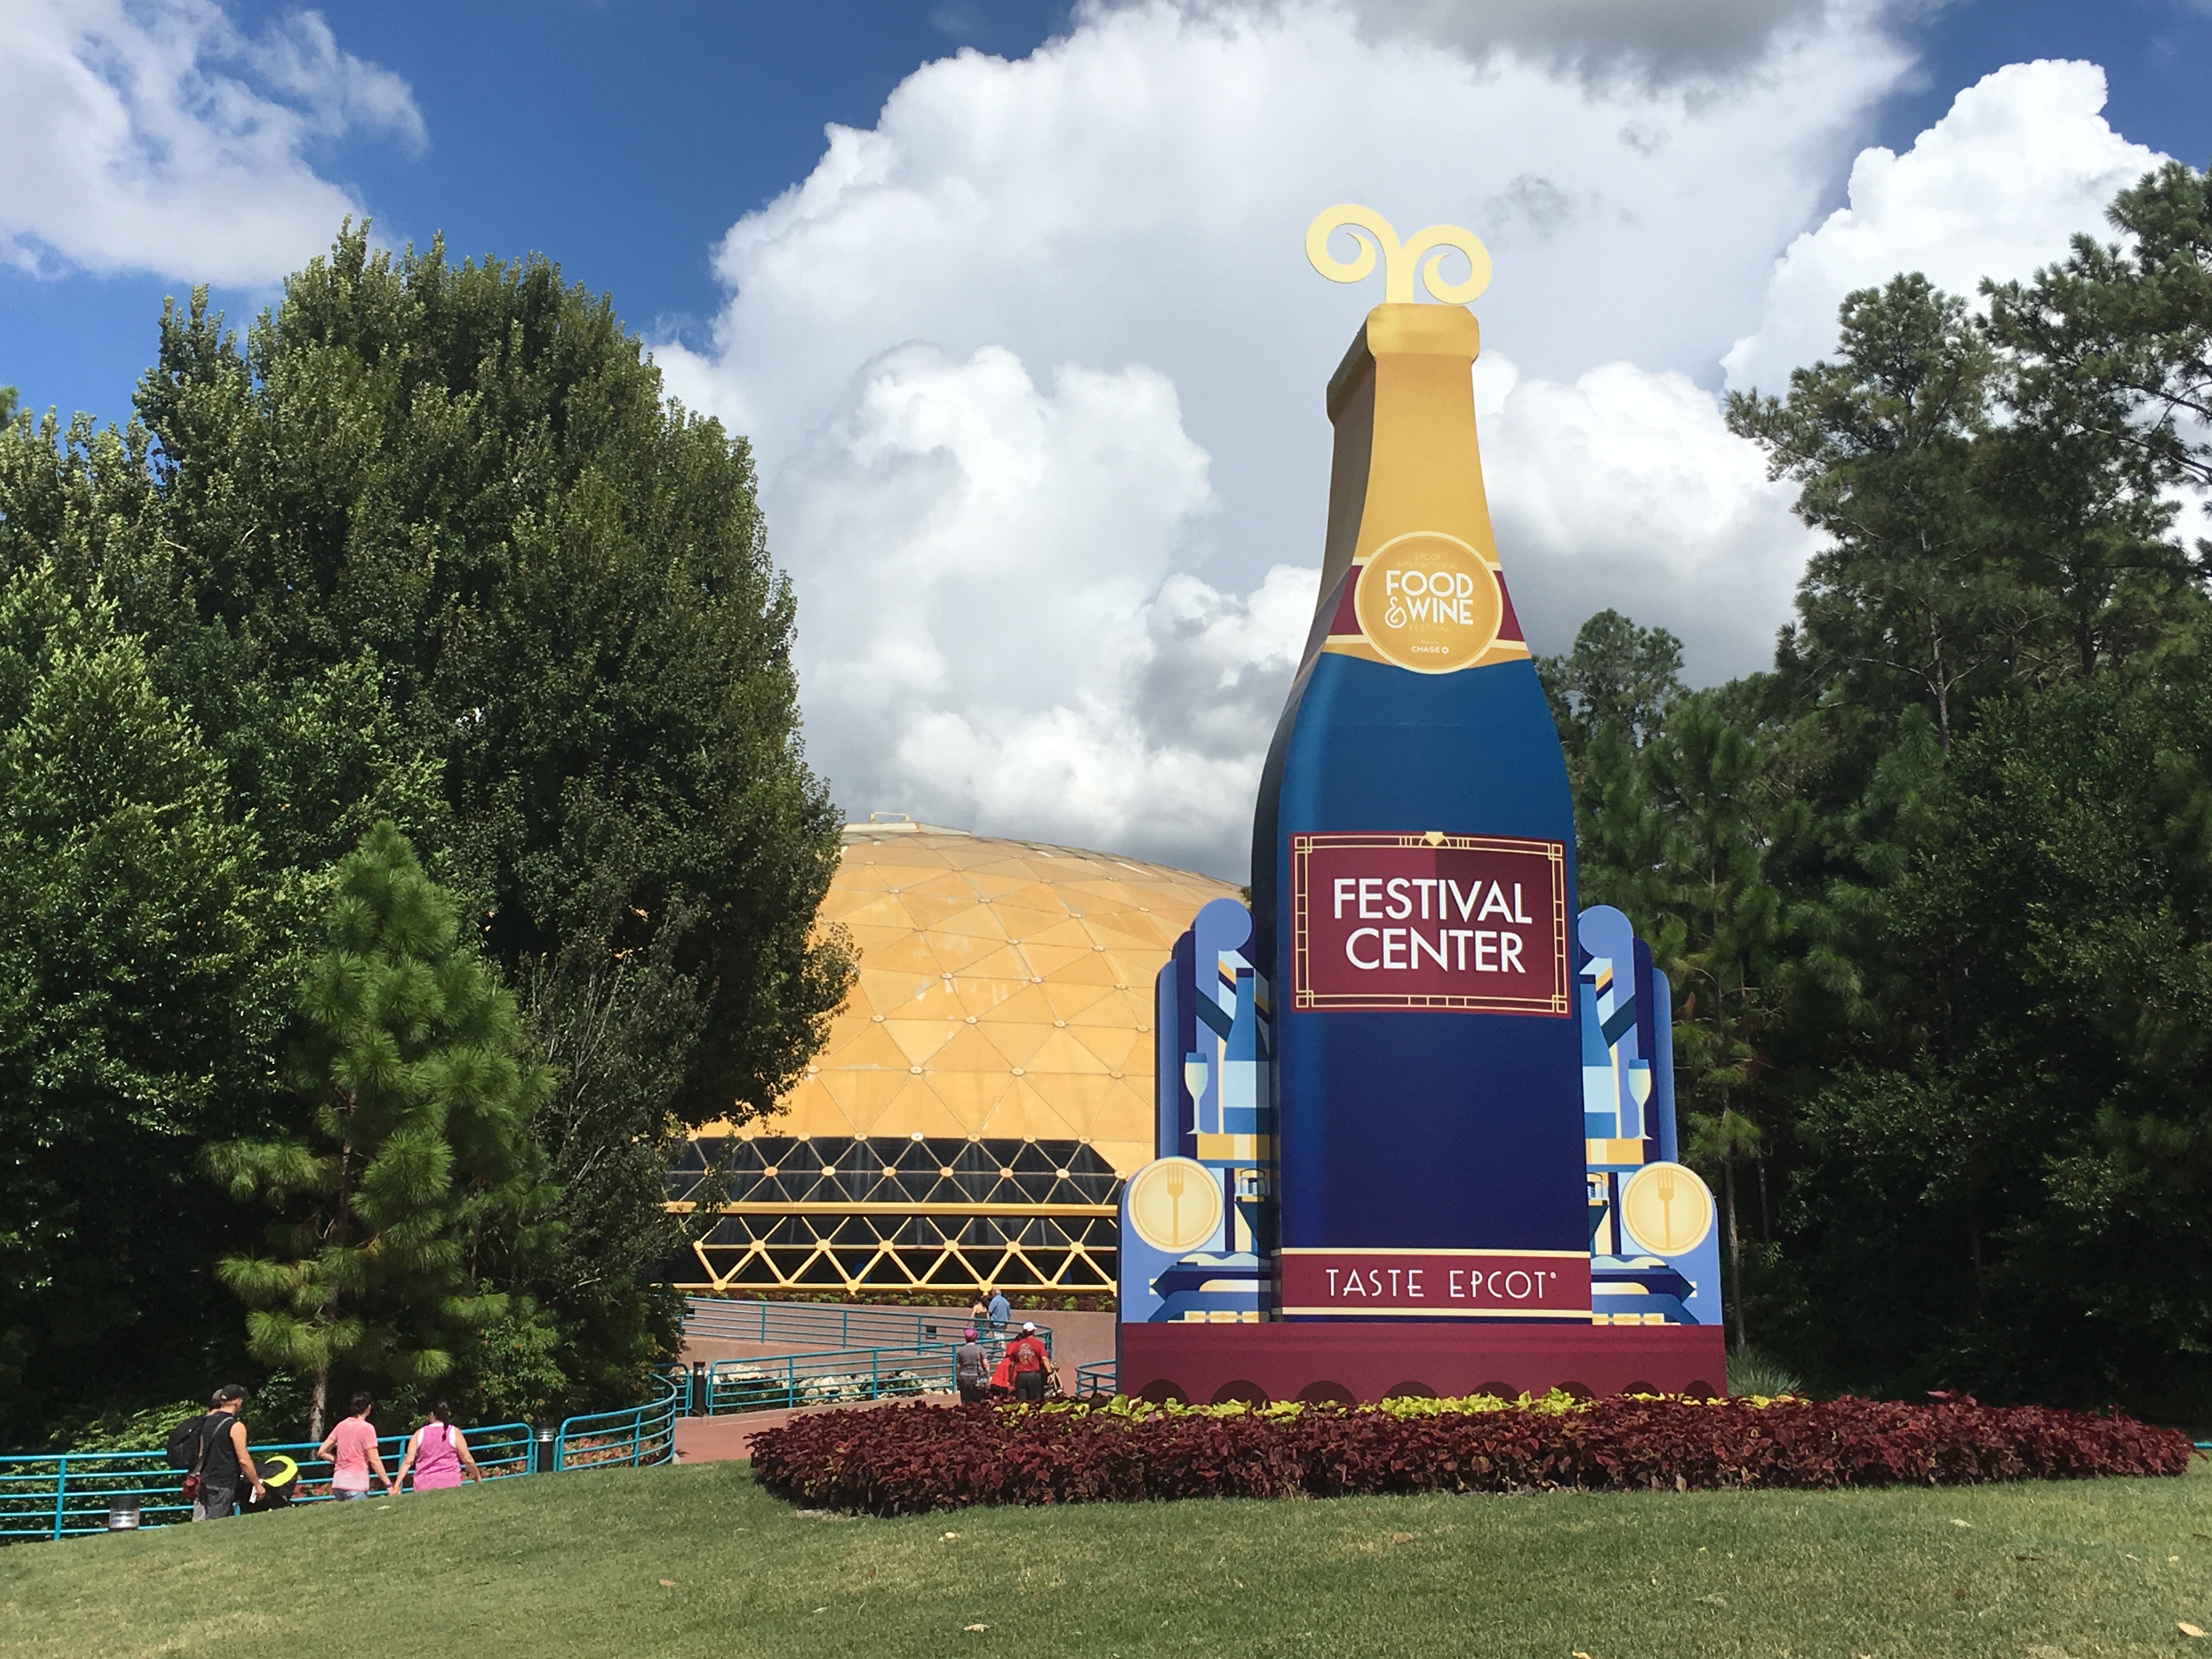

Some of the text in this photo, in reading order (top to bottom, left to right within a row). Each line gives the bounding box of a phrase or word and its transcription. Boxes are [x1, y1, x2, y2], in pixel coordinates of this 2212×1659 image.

[1386, 570, 1474, 599] FOOD
[1405, 596, 1474, 625] WINE
[1334, 878, 1532, 924] FESTIVAL
[1345, 926, 1526, 973] CENTER
[1325, 1268, 1424, 1297] TASTE
